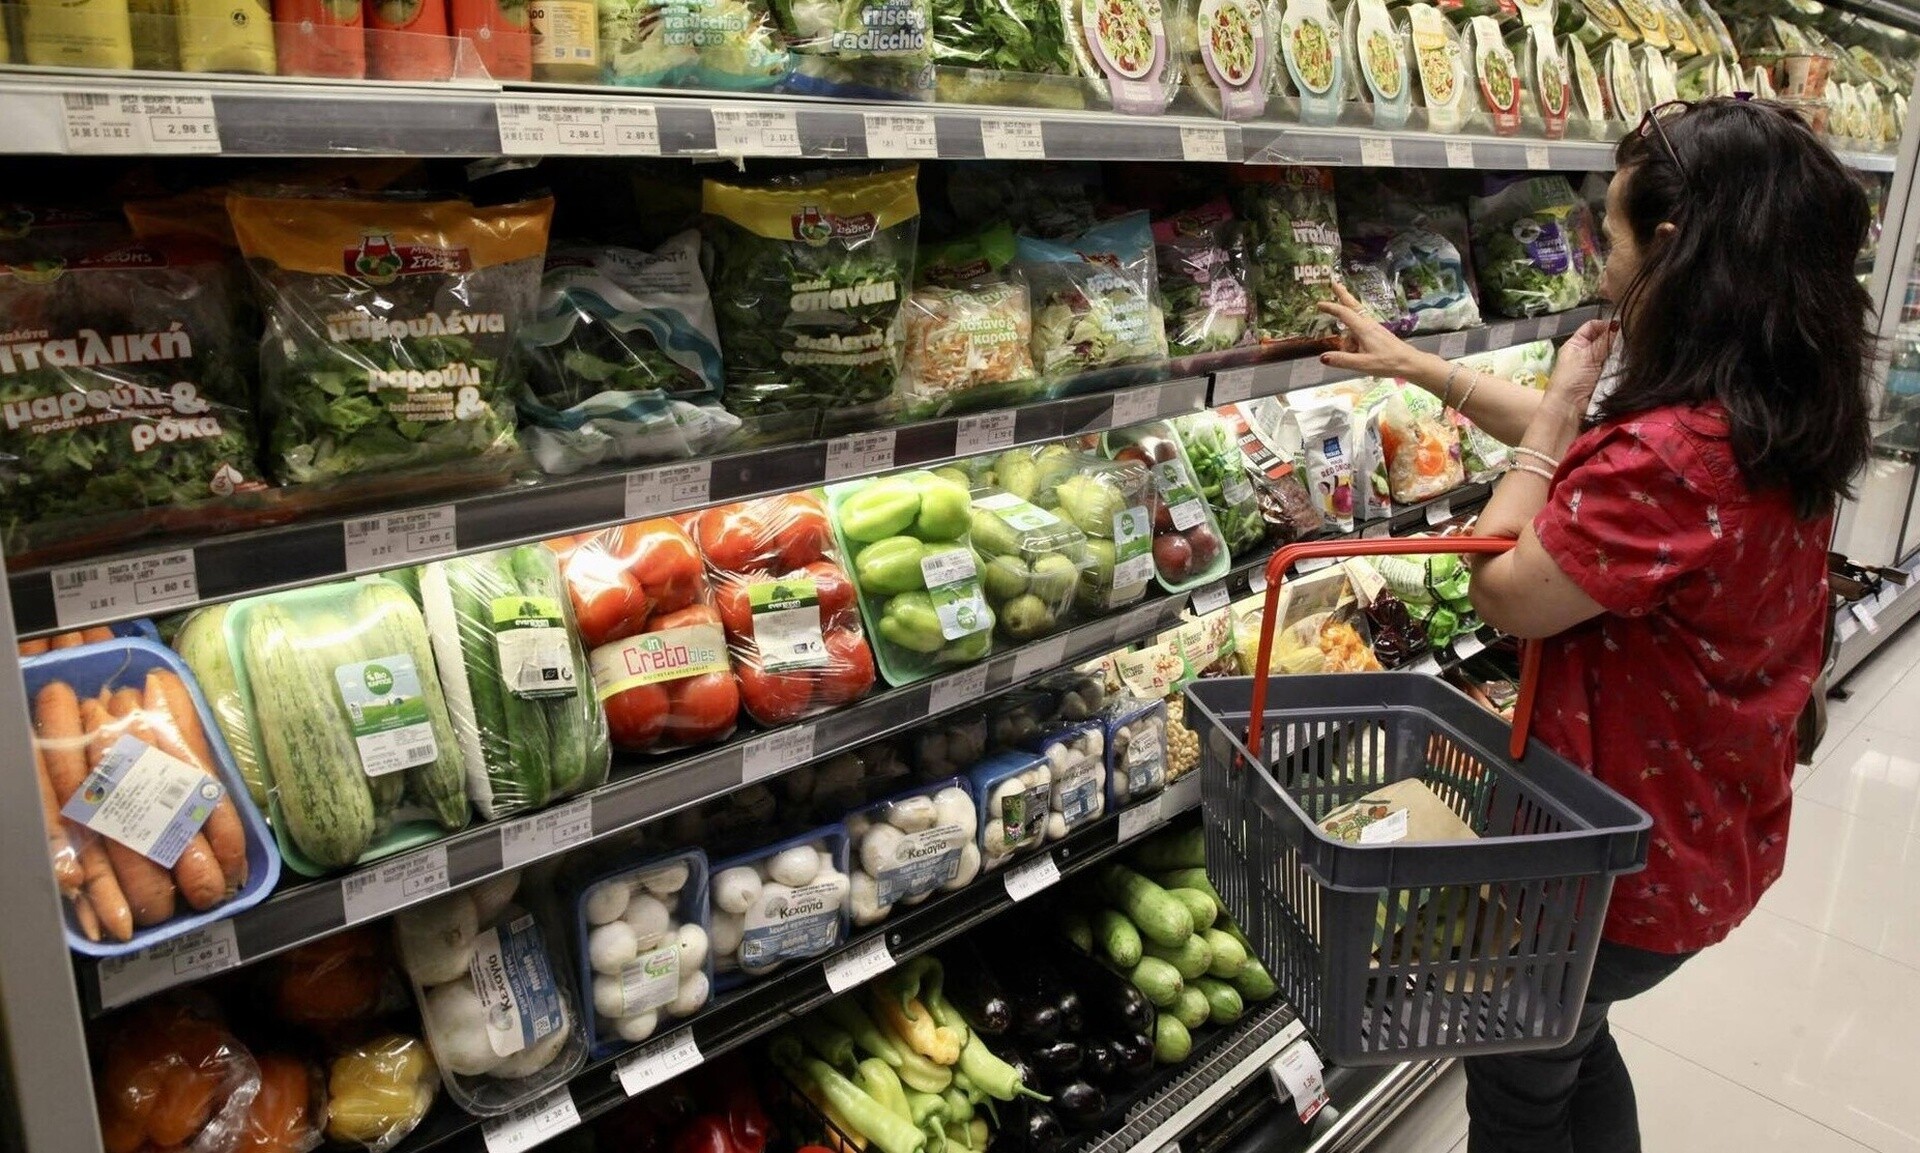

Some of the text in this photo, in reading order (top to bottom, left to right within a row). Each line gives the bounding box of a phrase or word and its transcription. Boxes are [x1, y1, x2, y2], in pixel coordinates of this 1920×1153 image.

[862, 5, 915, 25] frisee
[833, 30, 924, 50] radicchio
[328, 311, 505, 342] μαρουλένια
[0, 320, 192, 374] ιταλική
[369, 362, 480, 393] μαρούλι
[2, 382, 210, 430] μαρούλι &
[455, 387, 486, 420] &
[31, 414, 93, 434] πράσινο
[131, 414, 222, 452] ρόκα
[908, 838, 947, 859] Κεχαγιά
[780, 900, 823, 919] Κεχαγιά
[489, 954, 512, 1011] Κεχαγιά
